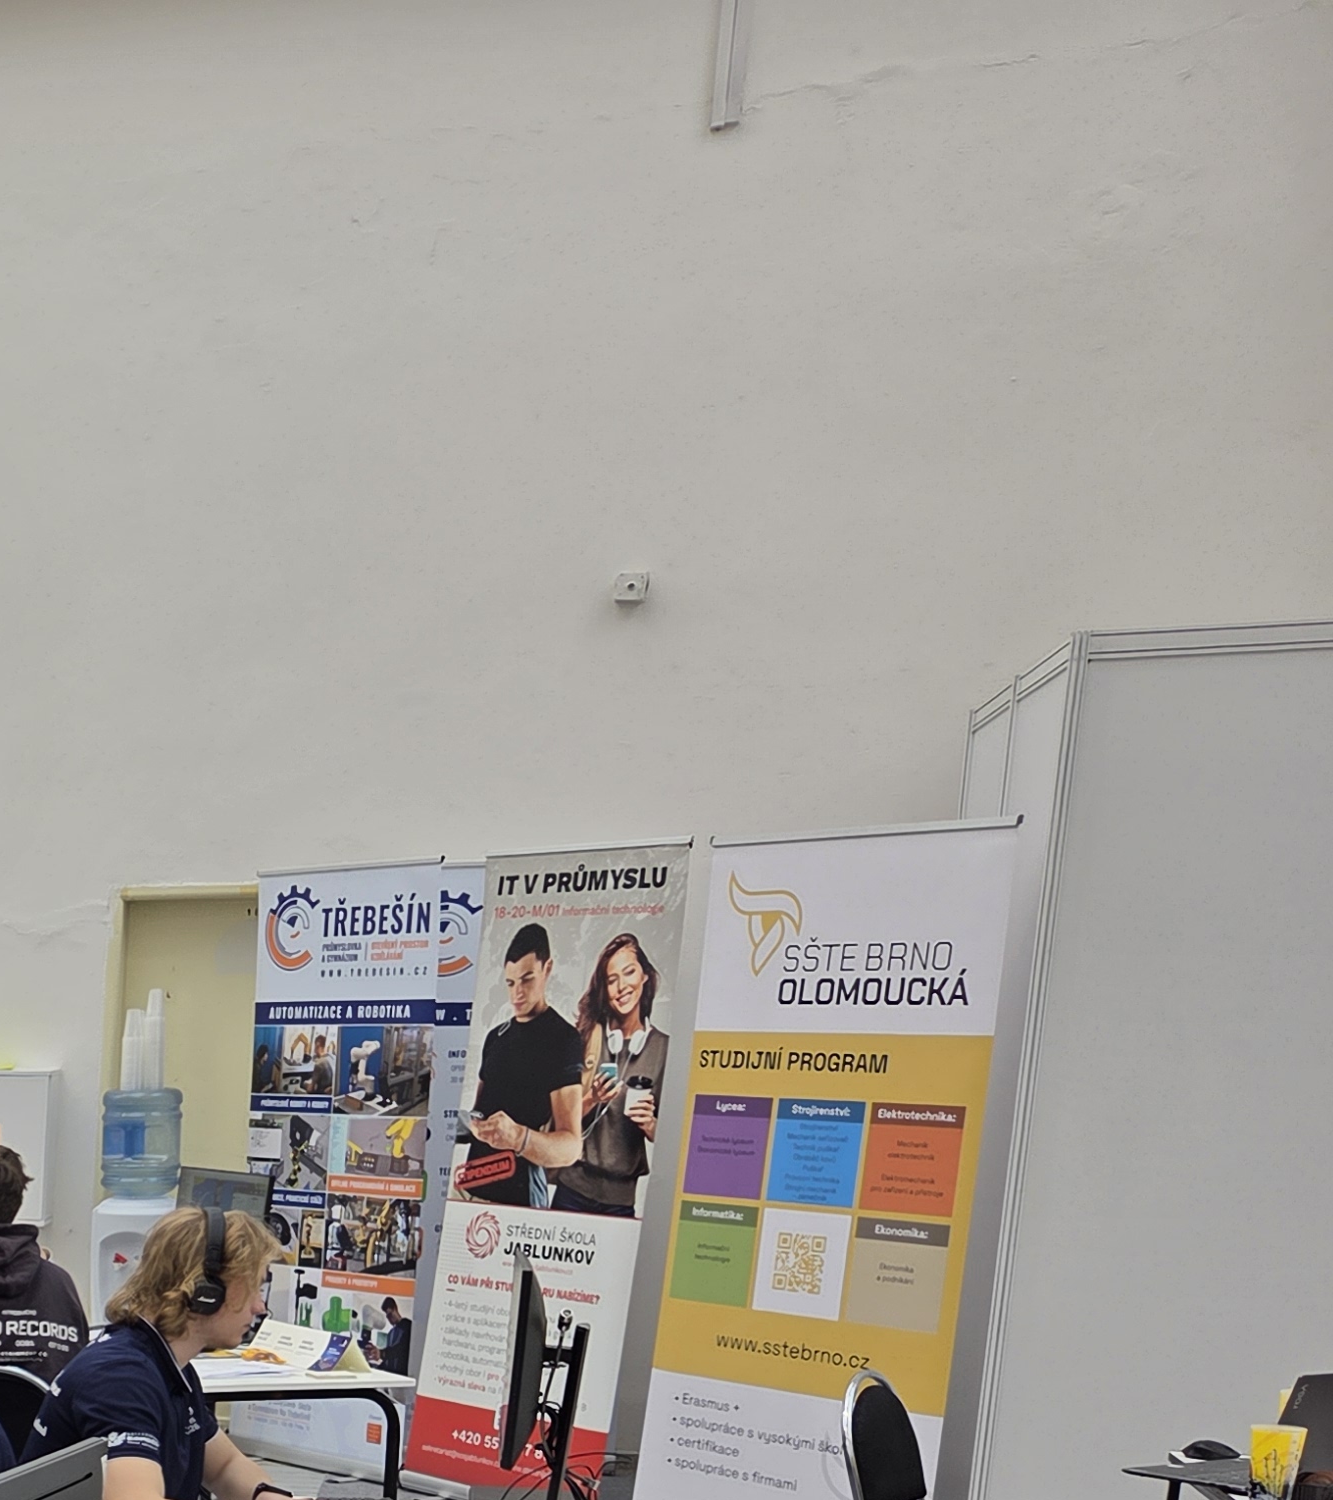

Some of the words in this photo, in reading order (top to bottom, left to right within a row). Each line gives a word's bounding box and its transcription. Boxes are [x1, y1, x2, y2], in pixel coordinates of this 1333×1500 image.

[498, 875, 520, 896] IT
[524, 874, 539, 894] V
[542, 864, 668, 893] PRŮMYSLU
[321, 892, 432, 938] TŘEBEŠÍN
[783, 937, 858, 972] SŠTE
[865, 941, 953, 972] BRNO
[778, 968, 969, 1006] OLOMOUCKÁ
[268, 1005, 342, 1019] AUTOMATIZACE
[345, 1005, 353, 1019] A
[357, 1004, 411, 1019] ROBOTIKA
[699, 1047, 784, 1070] STUDIJNÍ
[787, 1051, 889, 1074] PROGRAM
[506, 1222, 557, 1242] STŘEDNÍ
[559, 1227, 596, 1246] ŠKOLA
[503, 1241, 595, 1265] JABLUNKOV
[448, 1273, 459, 1285] CO
[461, 1273, 479, 1288] VÁM
[480, 1275, 493, 1290] PŘI
[5, 1320, 79, 1343] RECORDS
[715, 1332, 871, 1371] www.sstebrno.cz
[681, 1392, 731, 1412] Erasmus
[452, 1429, 482, 1446] +420
[677, 1435, 740, 1458] certifikace
[679, 1415, 745, 1437] spolupráce
[747, 1429, 755, 1438] s
[757, 1430, 816, 1451] vysokými
[817, 1440, 843, 1456] ško
[674, 1457, 740, 1480] spolupráce
[741, 1471, 749, 1481] s
[752, 1470, 797, 1491] firmami
